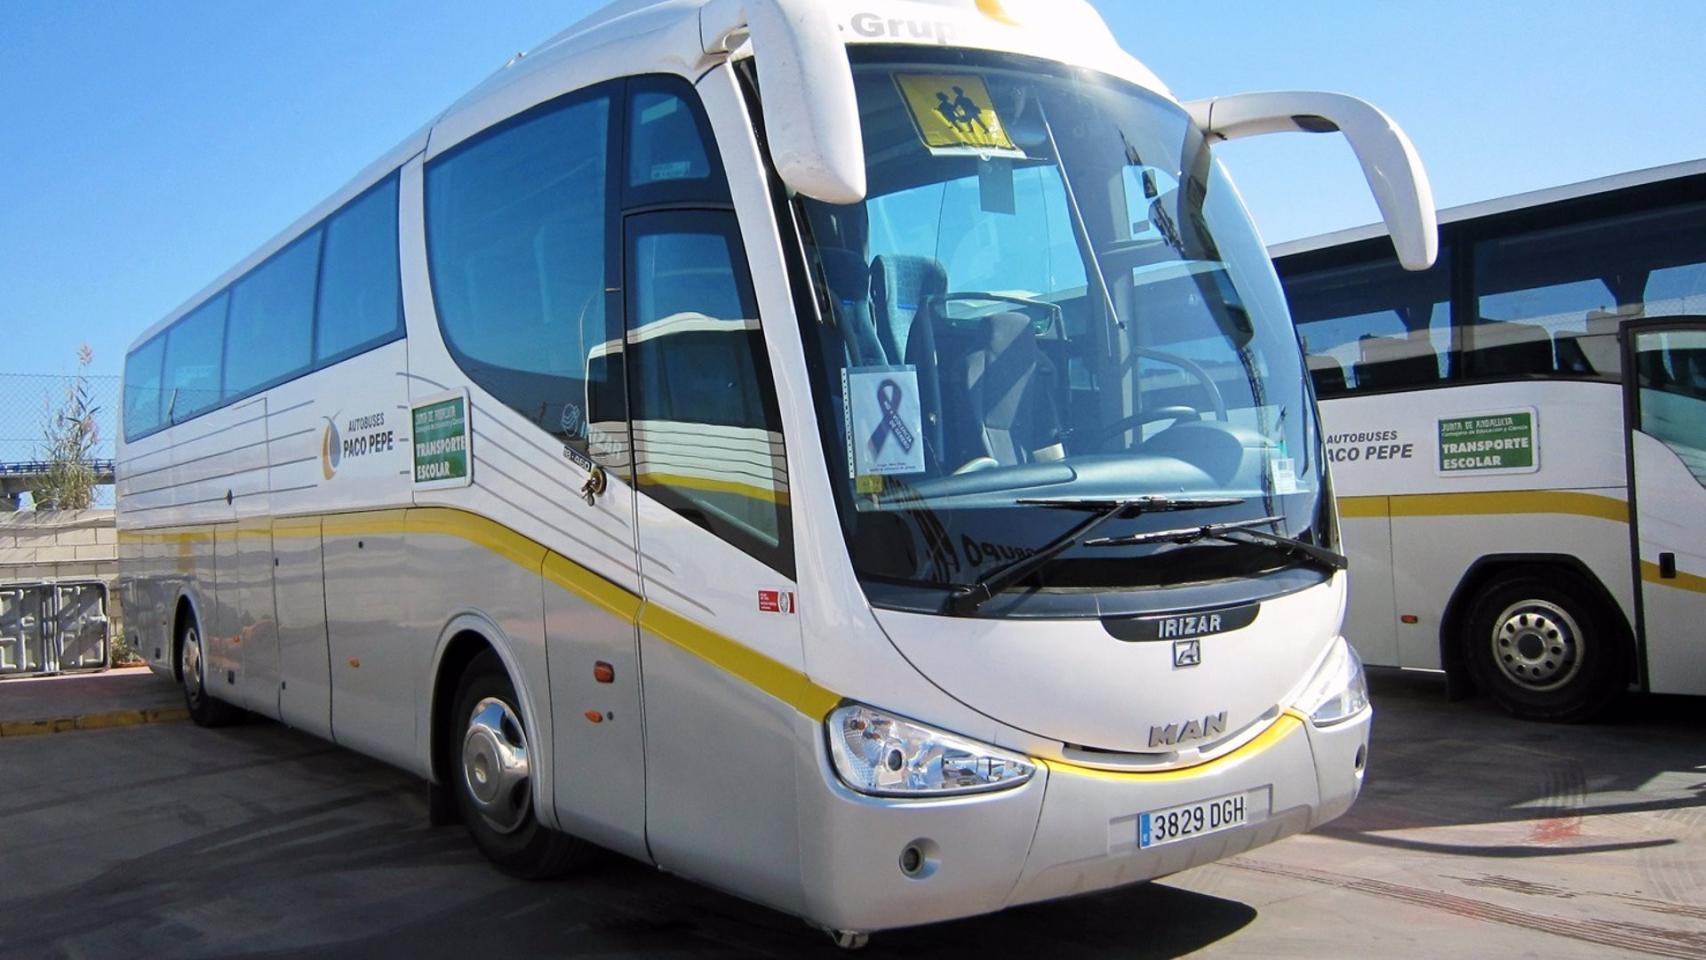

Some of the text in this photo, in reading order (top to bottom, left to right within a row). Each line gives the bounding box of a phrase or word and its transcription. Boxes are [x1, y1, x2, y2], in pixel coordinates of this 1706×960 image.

[348, 412, 385, 432] AUTOBUSES
[343, 436, 367, 459] PACO
[369, 430, 393, 454] PEPE
[416, 435, 467, 457] TRANSPORTE
[1327, 430, 1398, 444] AUTOBUSES
[1442, 437, 1529, 454] TRANSPORTE
[1328, 443, 1413, 462] ACO PEPE
[1443, 455, 1502, 469] ESCOLAR
[417, 461, 450, 480] ESCOLAR
[1158, 614, 1222, 639] IRIZAR
[1148, 711, 1228, 747] MAN
[1155, 806, 1205, 840] 3829
[1210, 796, 1244, 828] DGH
